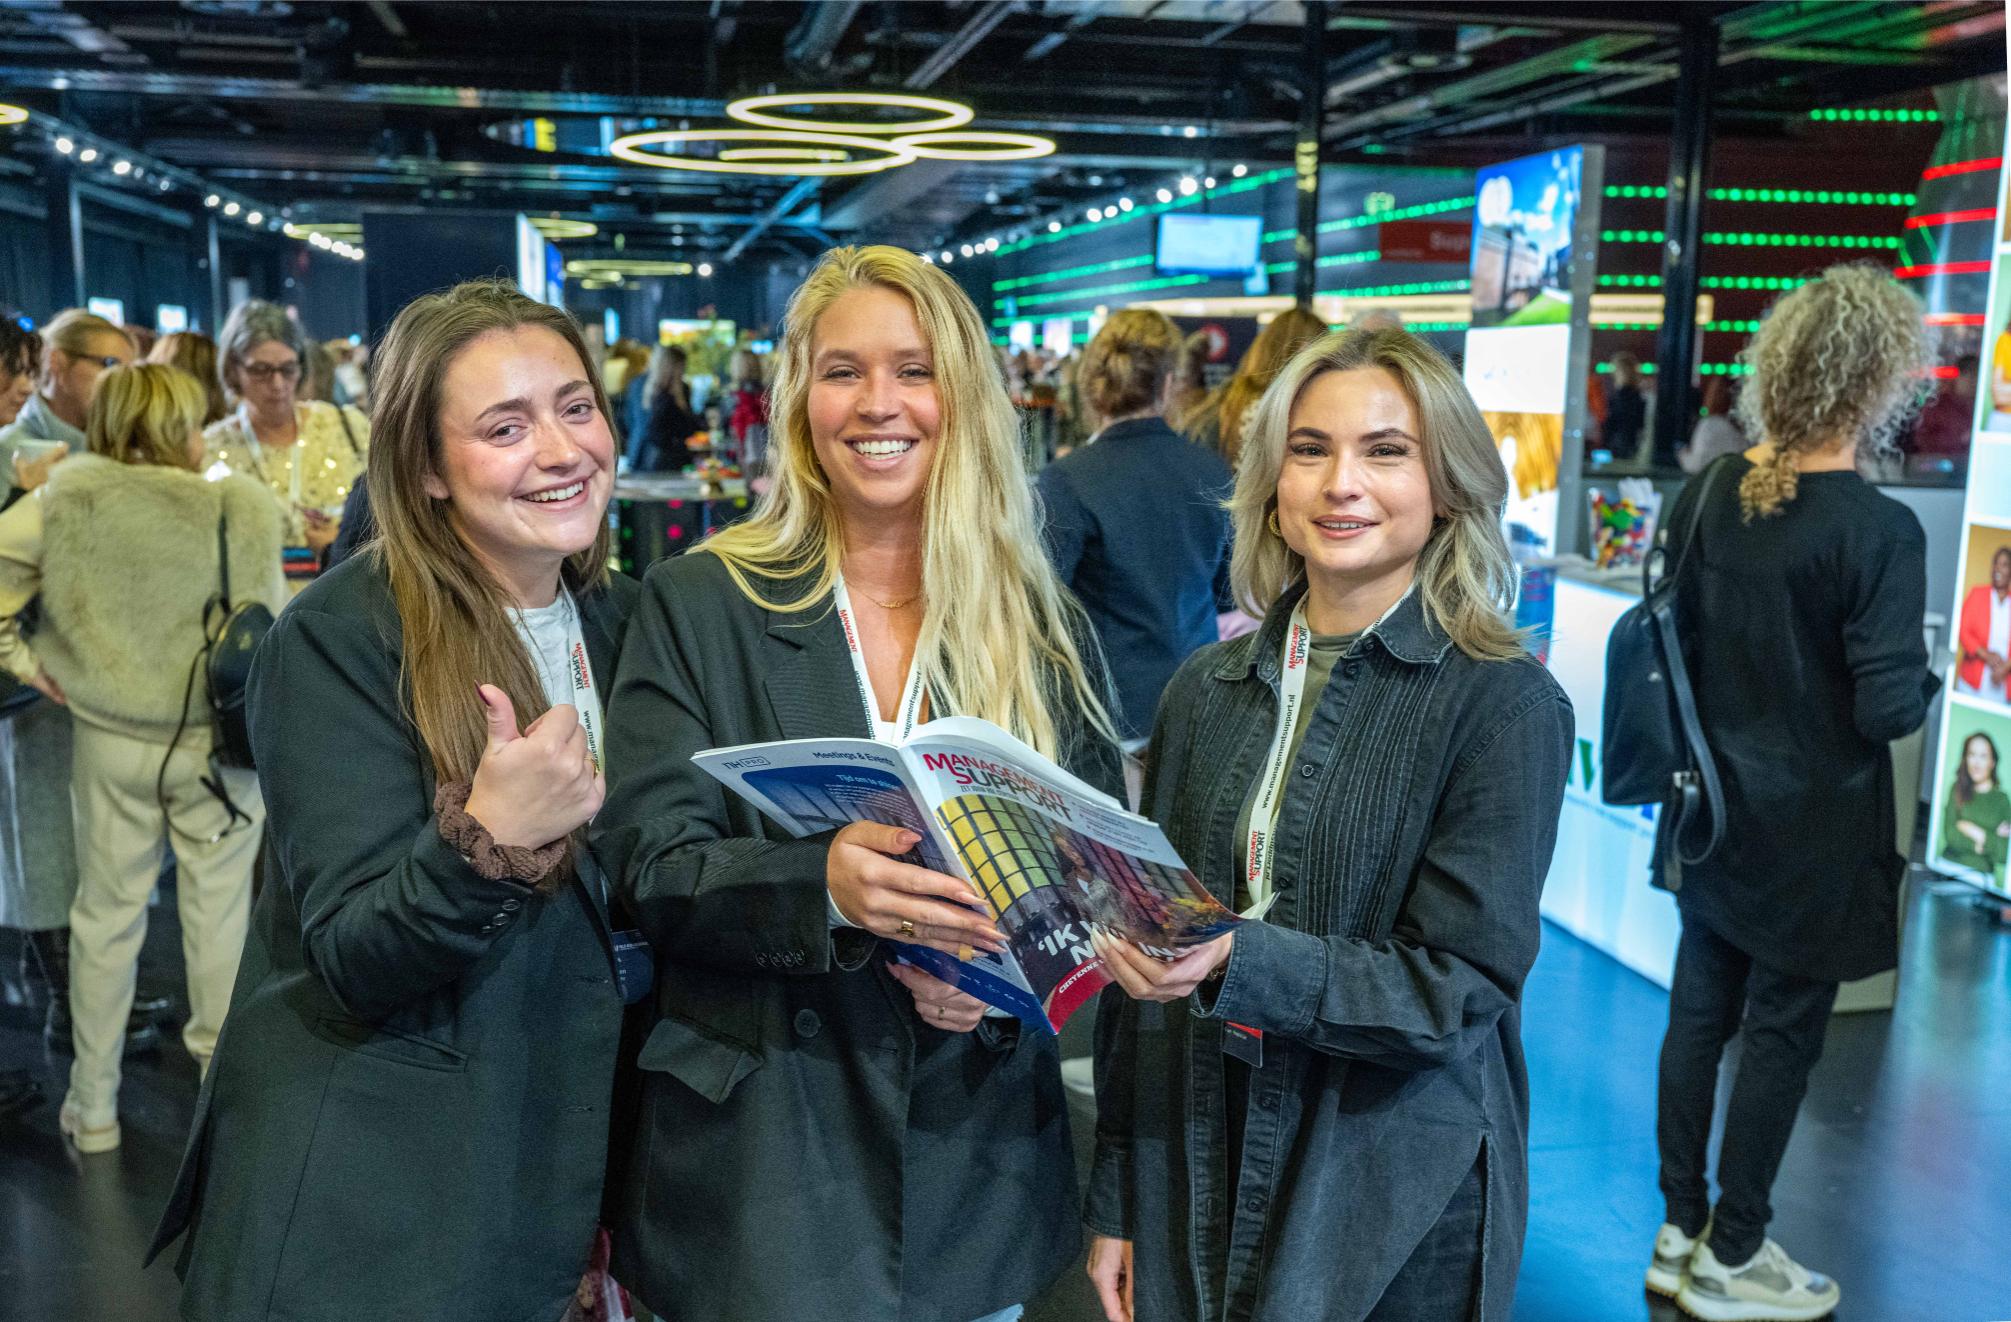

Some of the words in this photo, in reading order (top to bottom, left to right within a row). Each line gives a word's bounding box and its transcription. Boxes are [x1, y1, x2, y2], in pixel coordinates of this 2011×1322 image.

[839, 609, 858, 653] MANAGEMENT
[1288, 623, 1300, 670] MANAGEMENT
[1295, 626, 1308, 665] SUPPORT
[572, 650, 585, 690] SUPPORT
[575, 642, 590, 689] MANAGEMENT
[812, 752, 857, 760] Meetings
[865, 753, 895, 767] Events
[1262, 694, 1297, 809] www.managementsupport.nl
[922, 753, 1065, 806] MANAGEMENT
[955, 766, 1073, 822] SUPPORT
[1248, 830, 1259, 882] MANAGEMENT
[1253, 831, 1266, 877] SUPPORT
[1059, 962, 1098, 993] CHEYENNE
